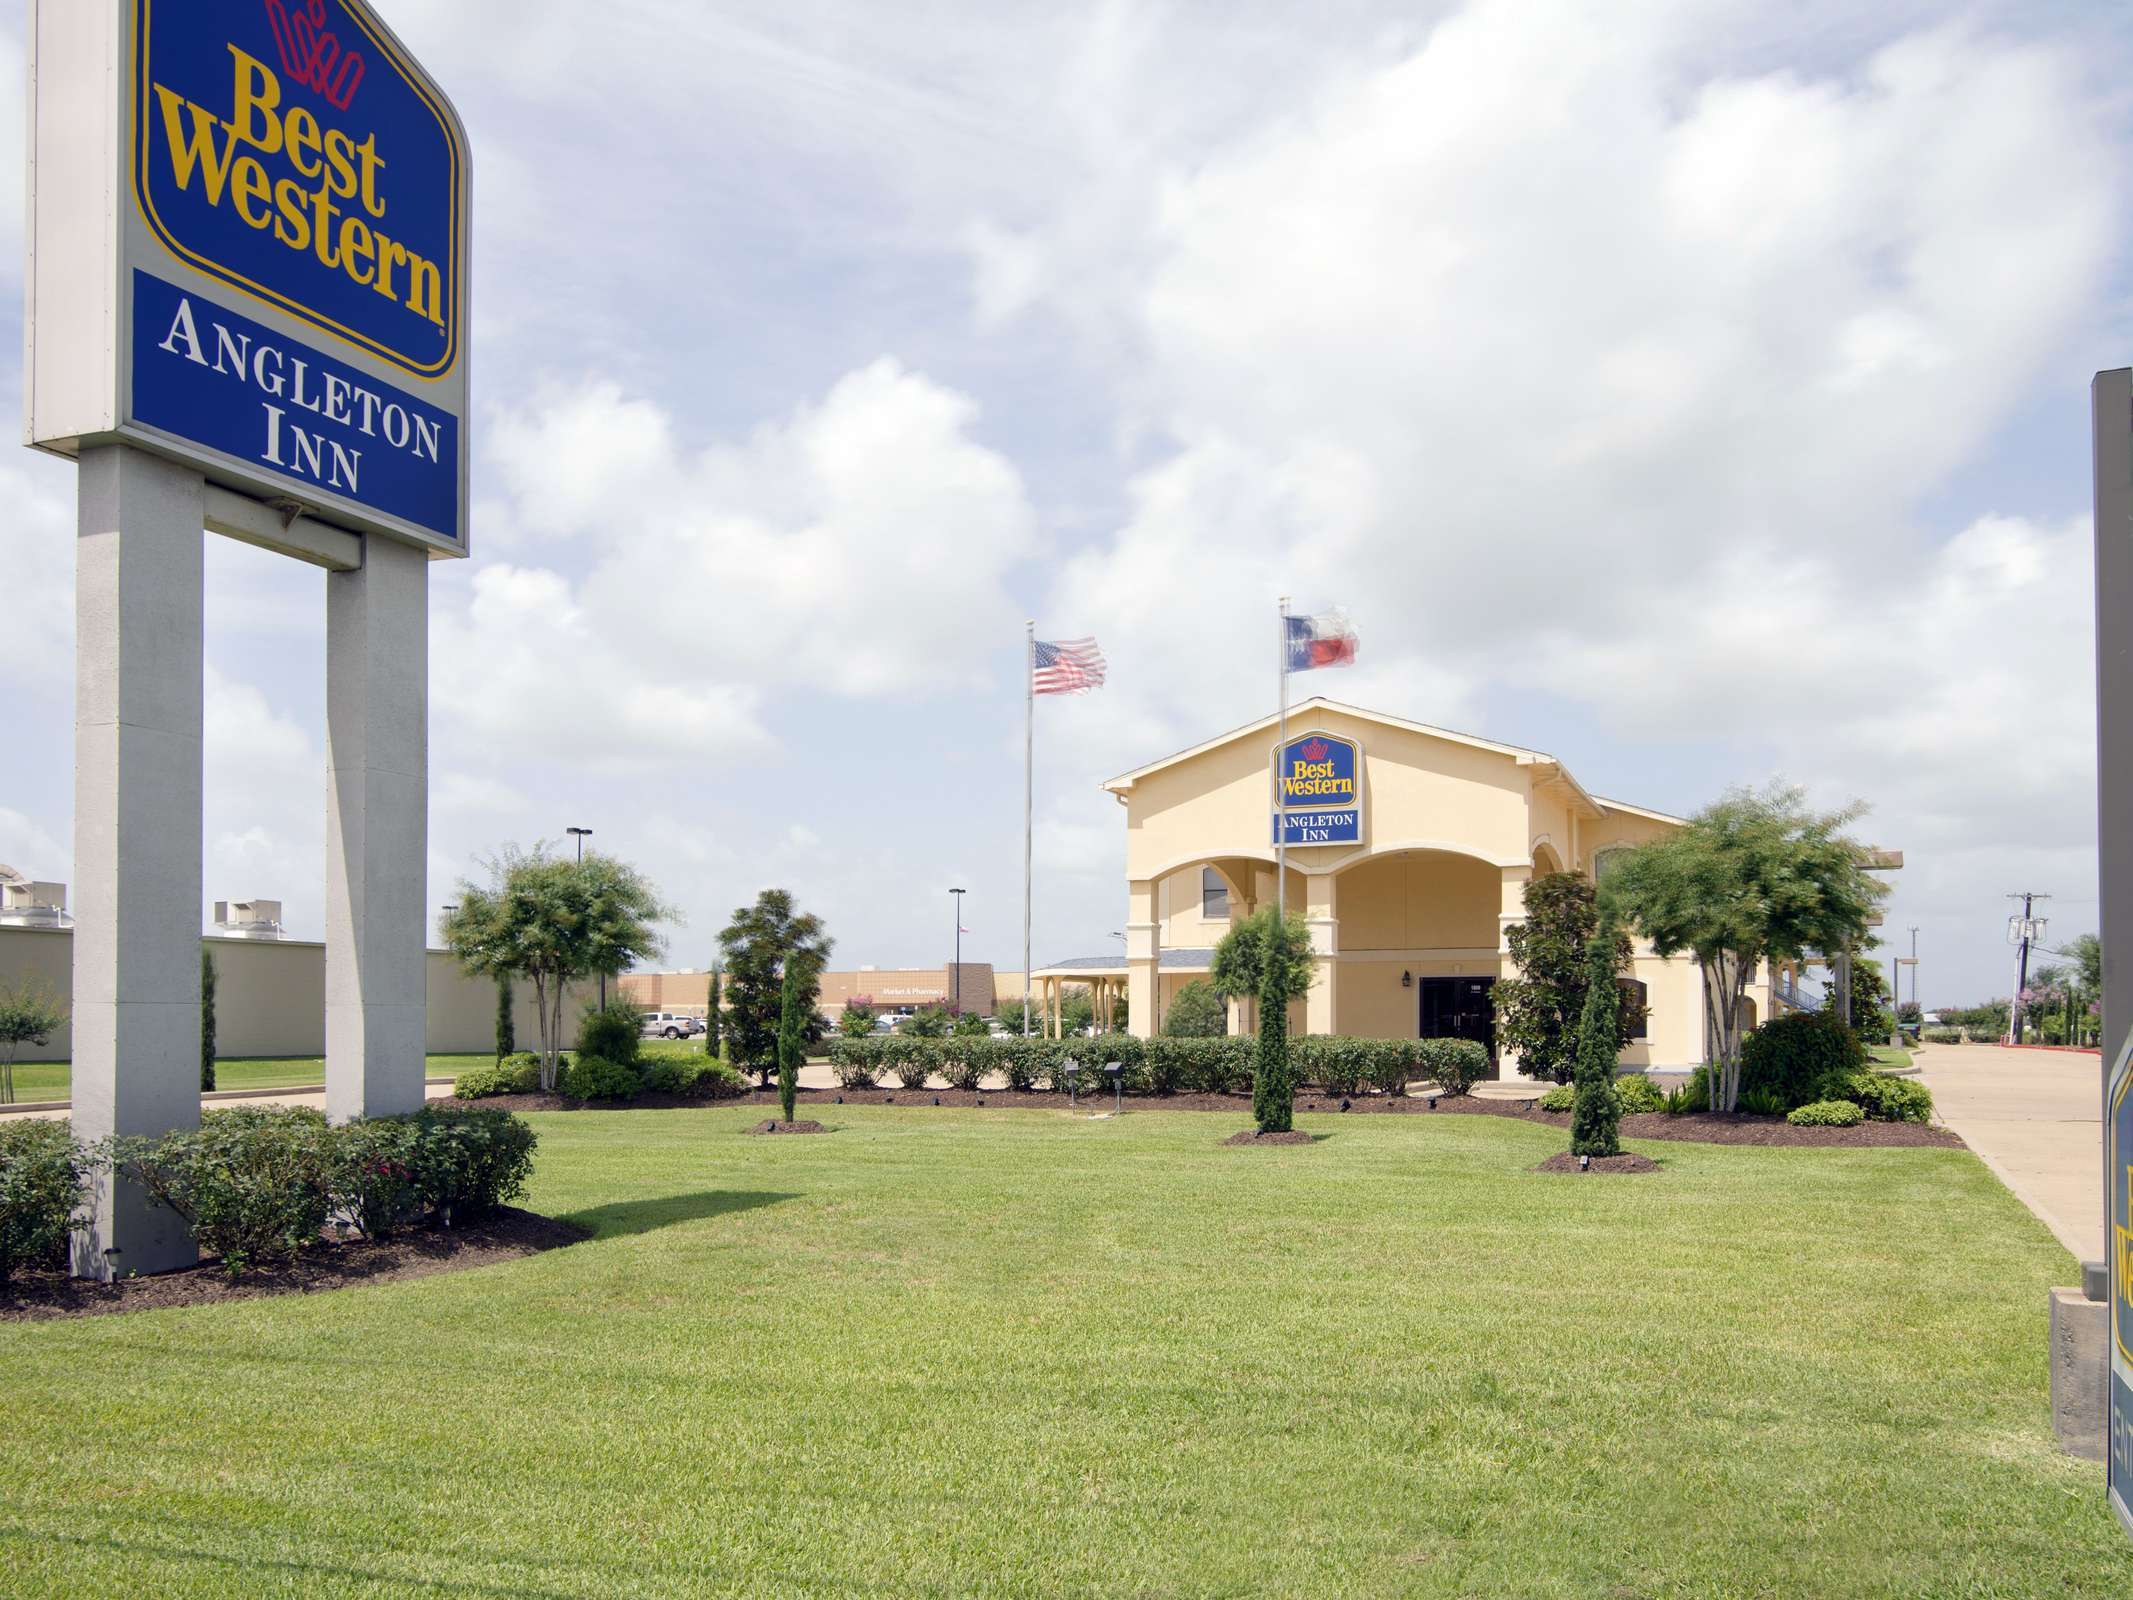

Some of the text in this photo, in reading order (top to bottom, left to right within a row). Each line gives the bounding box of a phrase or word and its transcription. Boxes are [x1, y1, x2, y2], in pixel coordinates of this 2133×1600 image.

[228, 42, 386, 218] Best
[153, 82, 446, 325] Western
[158, 298, 442, 464] ANGLETON
[261, 402, 362, 494] INN
[1279, 777, 1353, 797] Western
[1293, 759, 1335, 780] Best
[1302, 828, 1329, 841] INN
